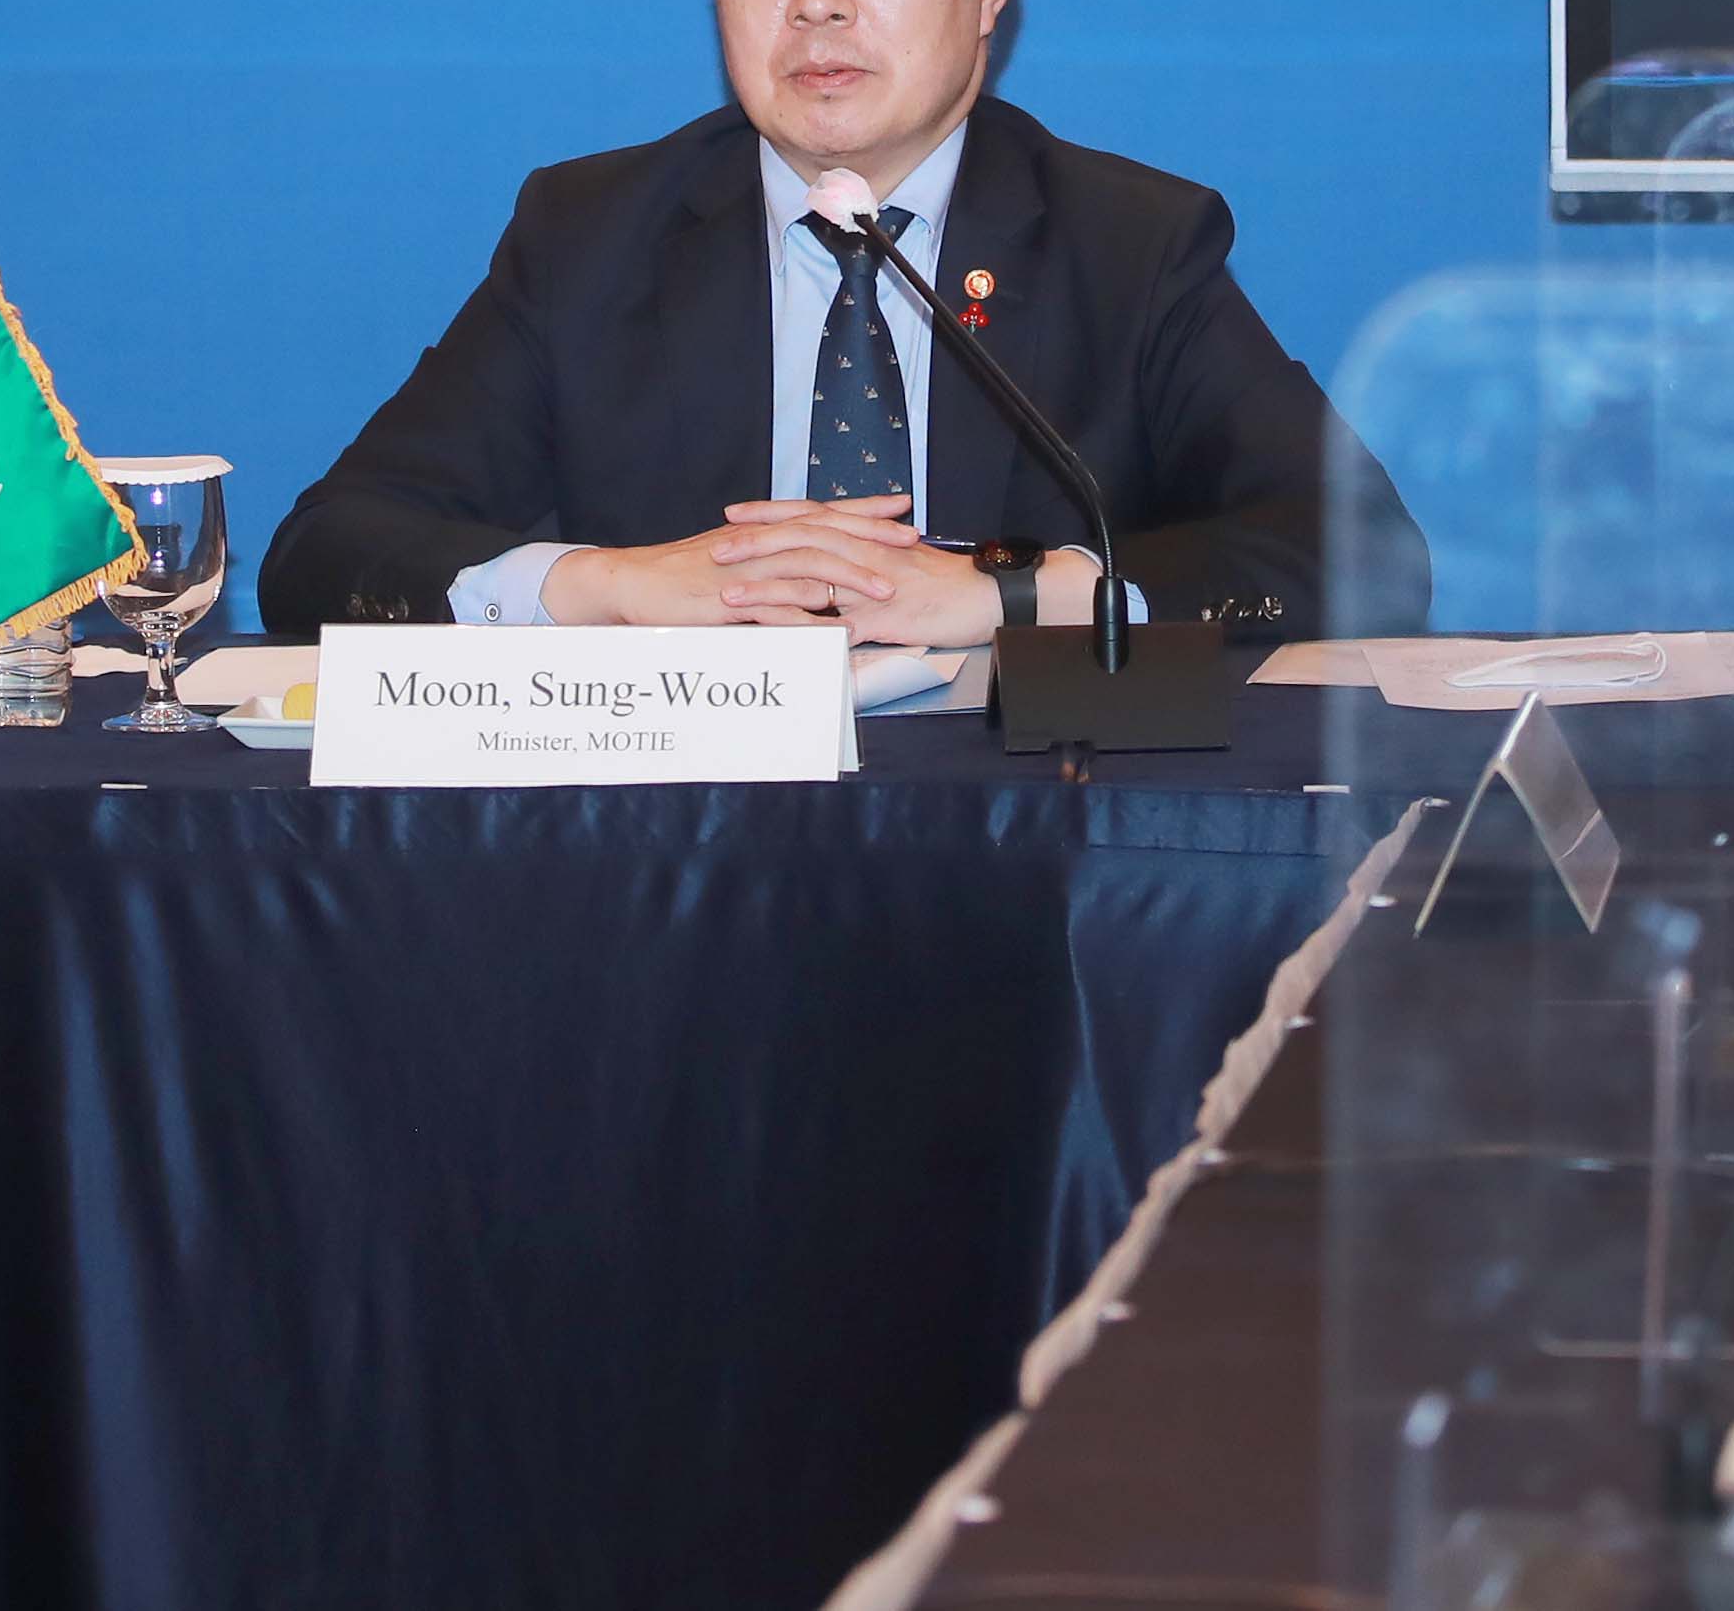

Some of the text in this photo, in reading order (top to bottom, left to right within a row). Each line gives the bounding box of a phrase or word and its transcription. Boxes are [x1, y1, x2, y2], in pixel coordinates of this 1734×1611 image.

[374, 669, 784, 717] Moon, Sung-Wook
[477, 731, 676, 754] Minister, MOTIE
